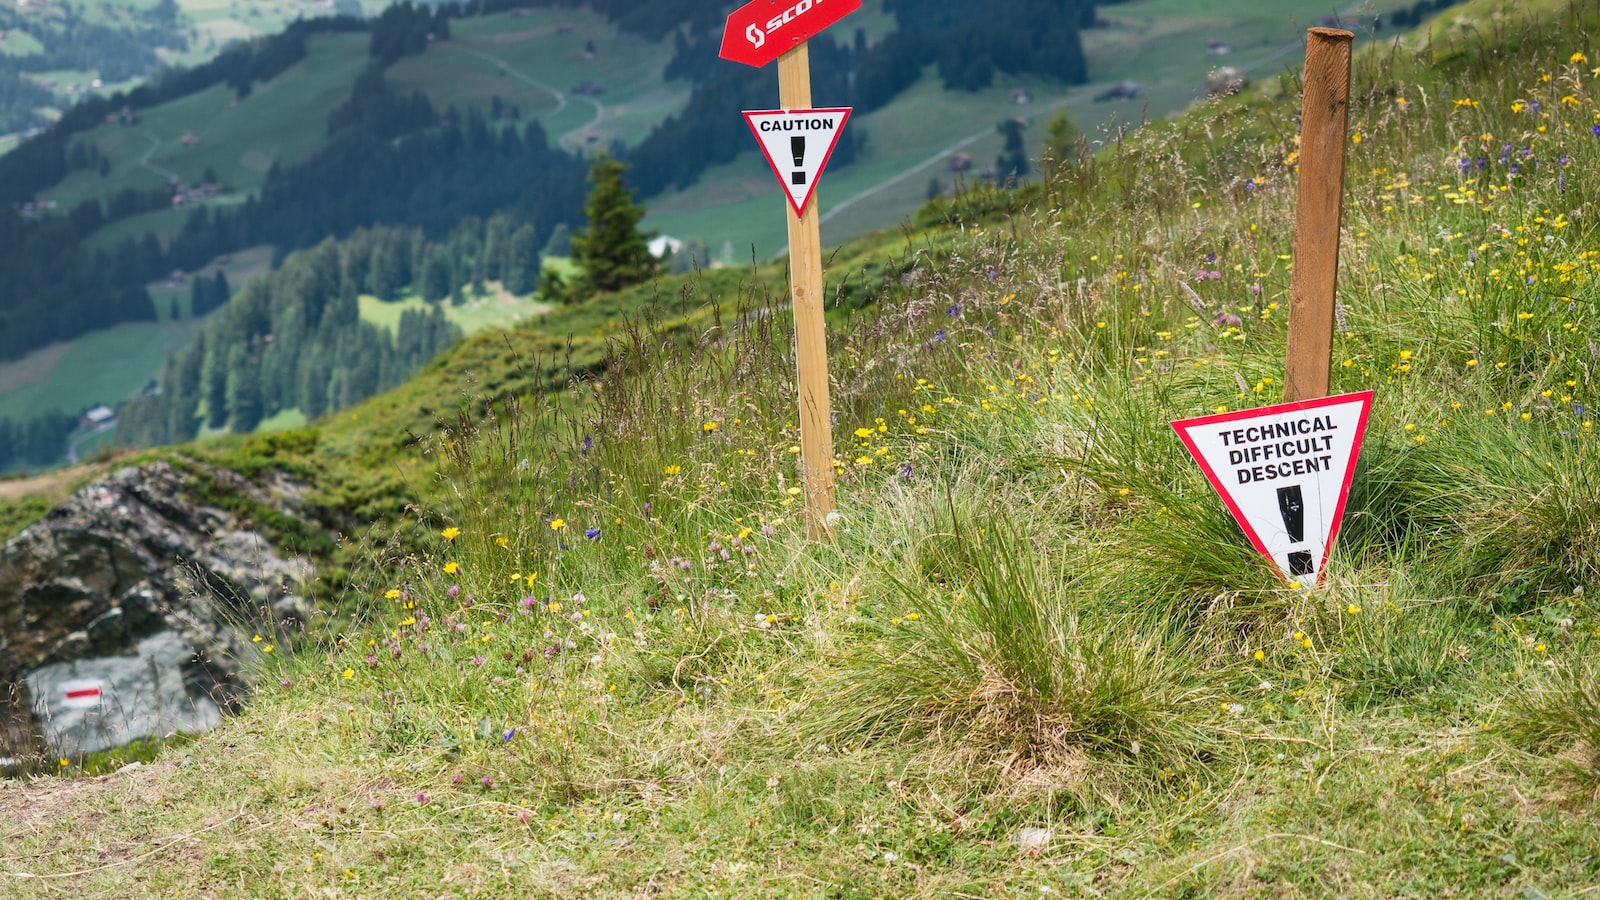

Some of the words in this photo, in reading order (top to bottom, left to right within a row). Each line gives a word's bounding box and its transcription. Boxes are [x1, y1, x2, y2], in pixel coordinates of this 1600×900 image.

[766, 0, 823, 34] SCO
[760, 118, 833, 132] CAUTION
[1219, 415, 1338, 446] TECHNICAL
[1229, 435, 1333, 466] DIFFICULT
[1237, 455, 1332, 485] DESCENT
